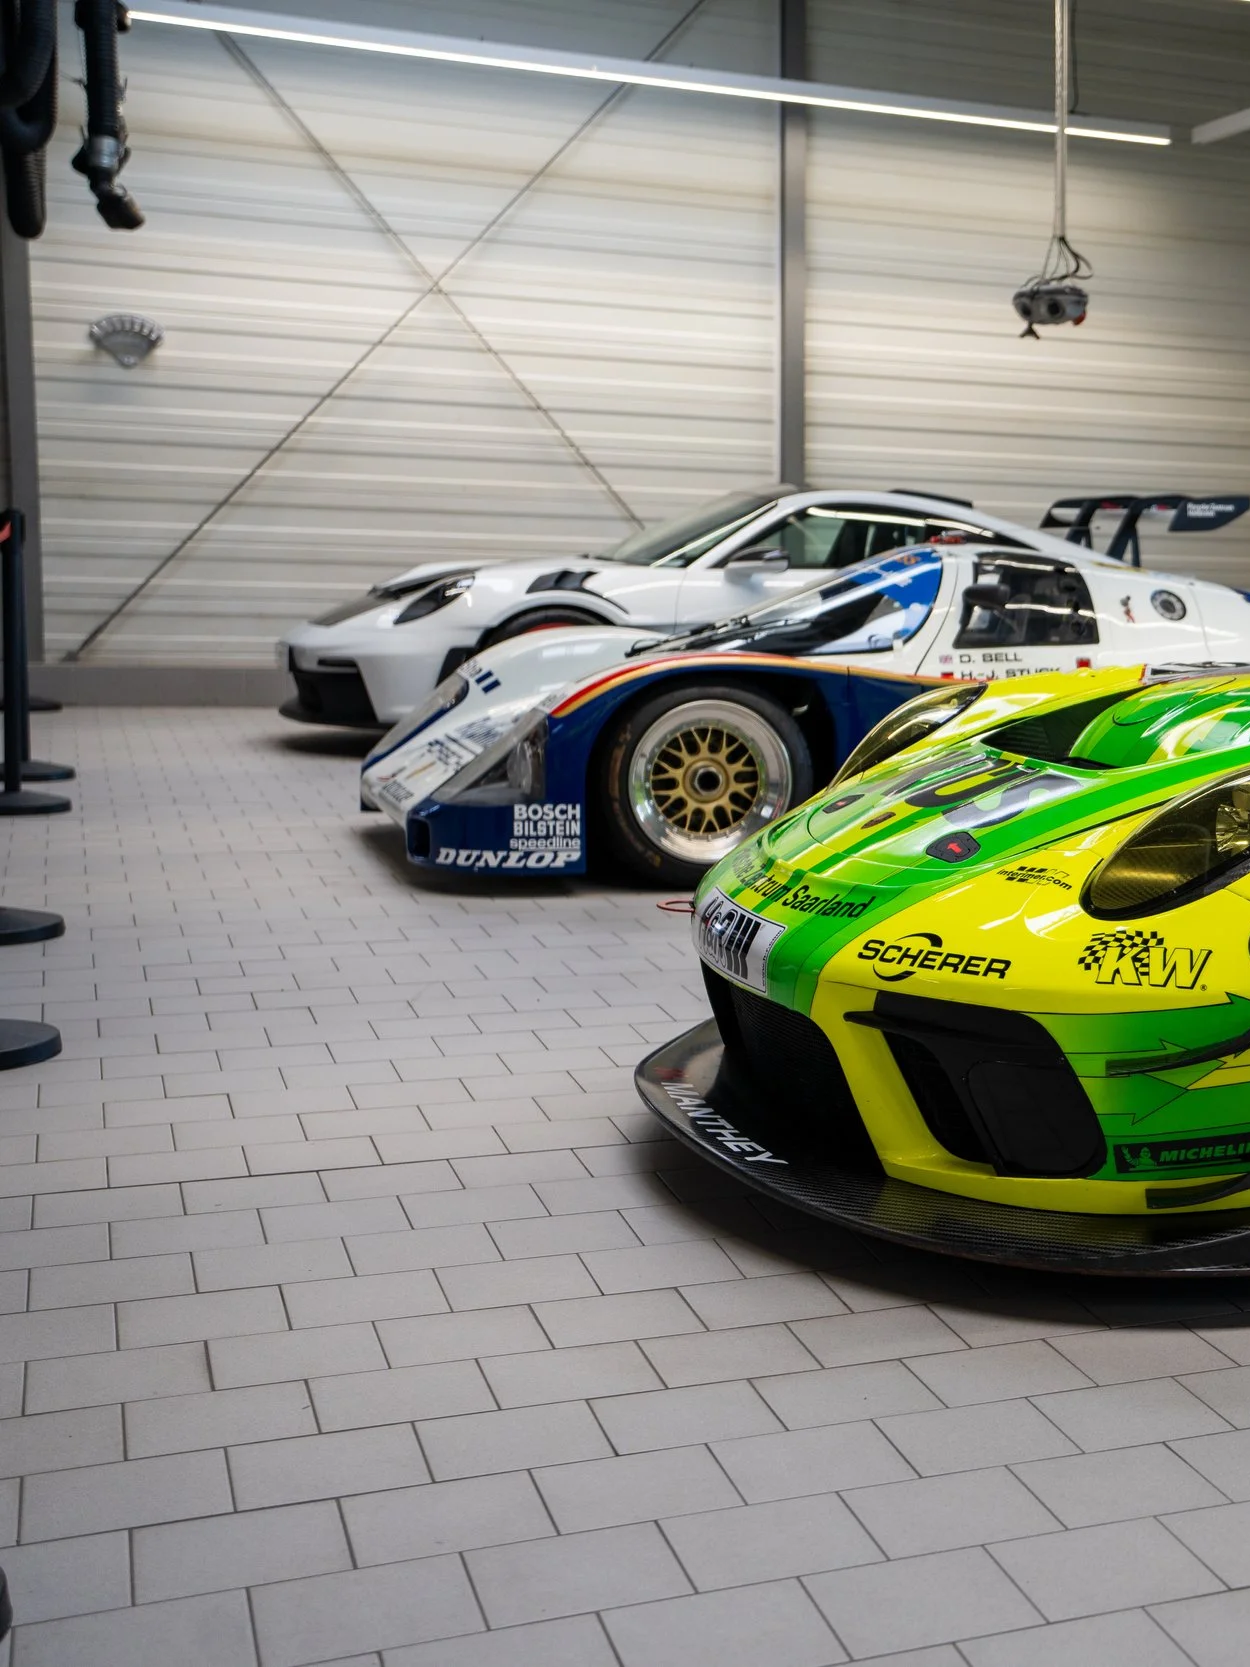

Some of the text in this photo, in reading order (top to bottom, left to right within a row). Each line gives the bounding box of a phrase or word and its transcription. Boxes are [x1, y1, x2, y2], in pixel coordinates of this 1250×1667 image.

[982, 652, 1023, 663] BELL
[513, 803, 581, 820] BOSCH
[513, 820, 581, 836] BILSTEIN
[509, 836, 581, 850] speedline
[435, 847, 582, 868] DUNLOP
[997, 868, 1073, 890] interimer.com
[781, 884, 877, 920] Saarland
[857, 938, 1012, 980] SCHERER
[1095, 946, 1213, 990] KW
[661, 1082, 789, 1165] MANTHEY
